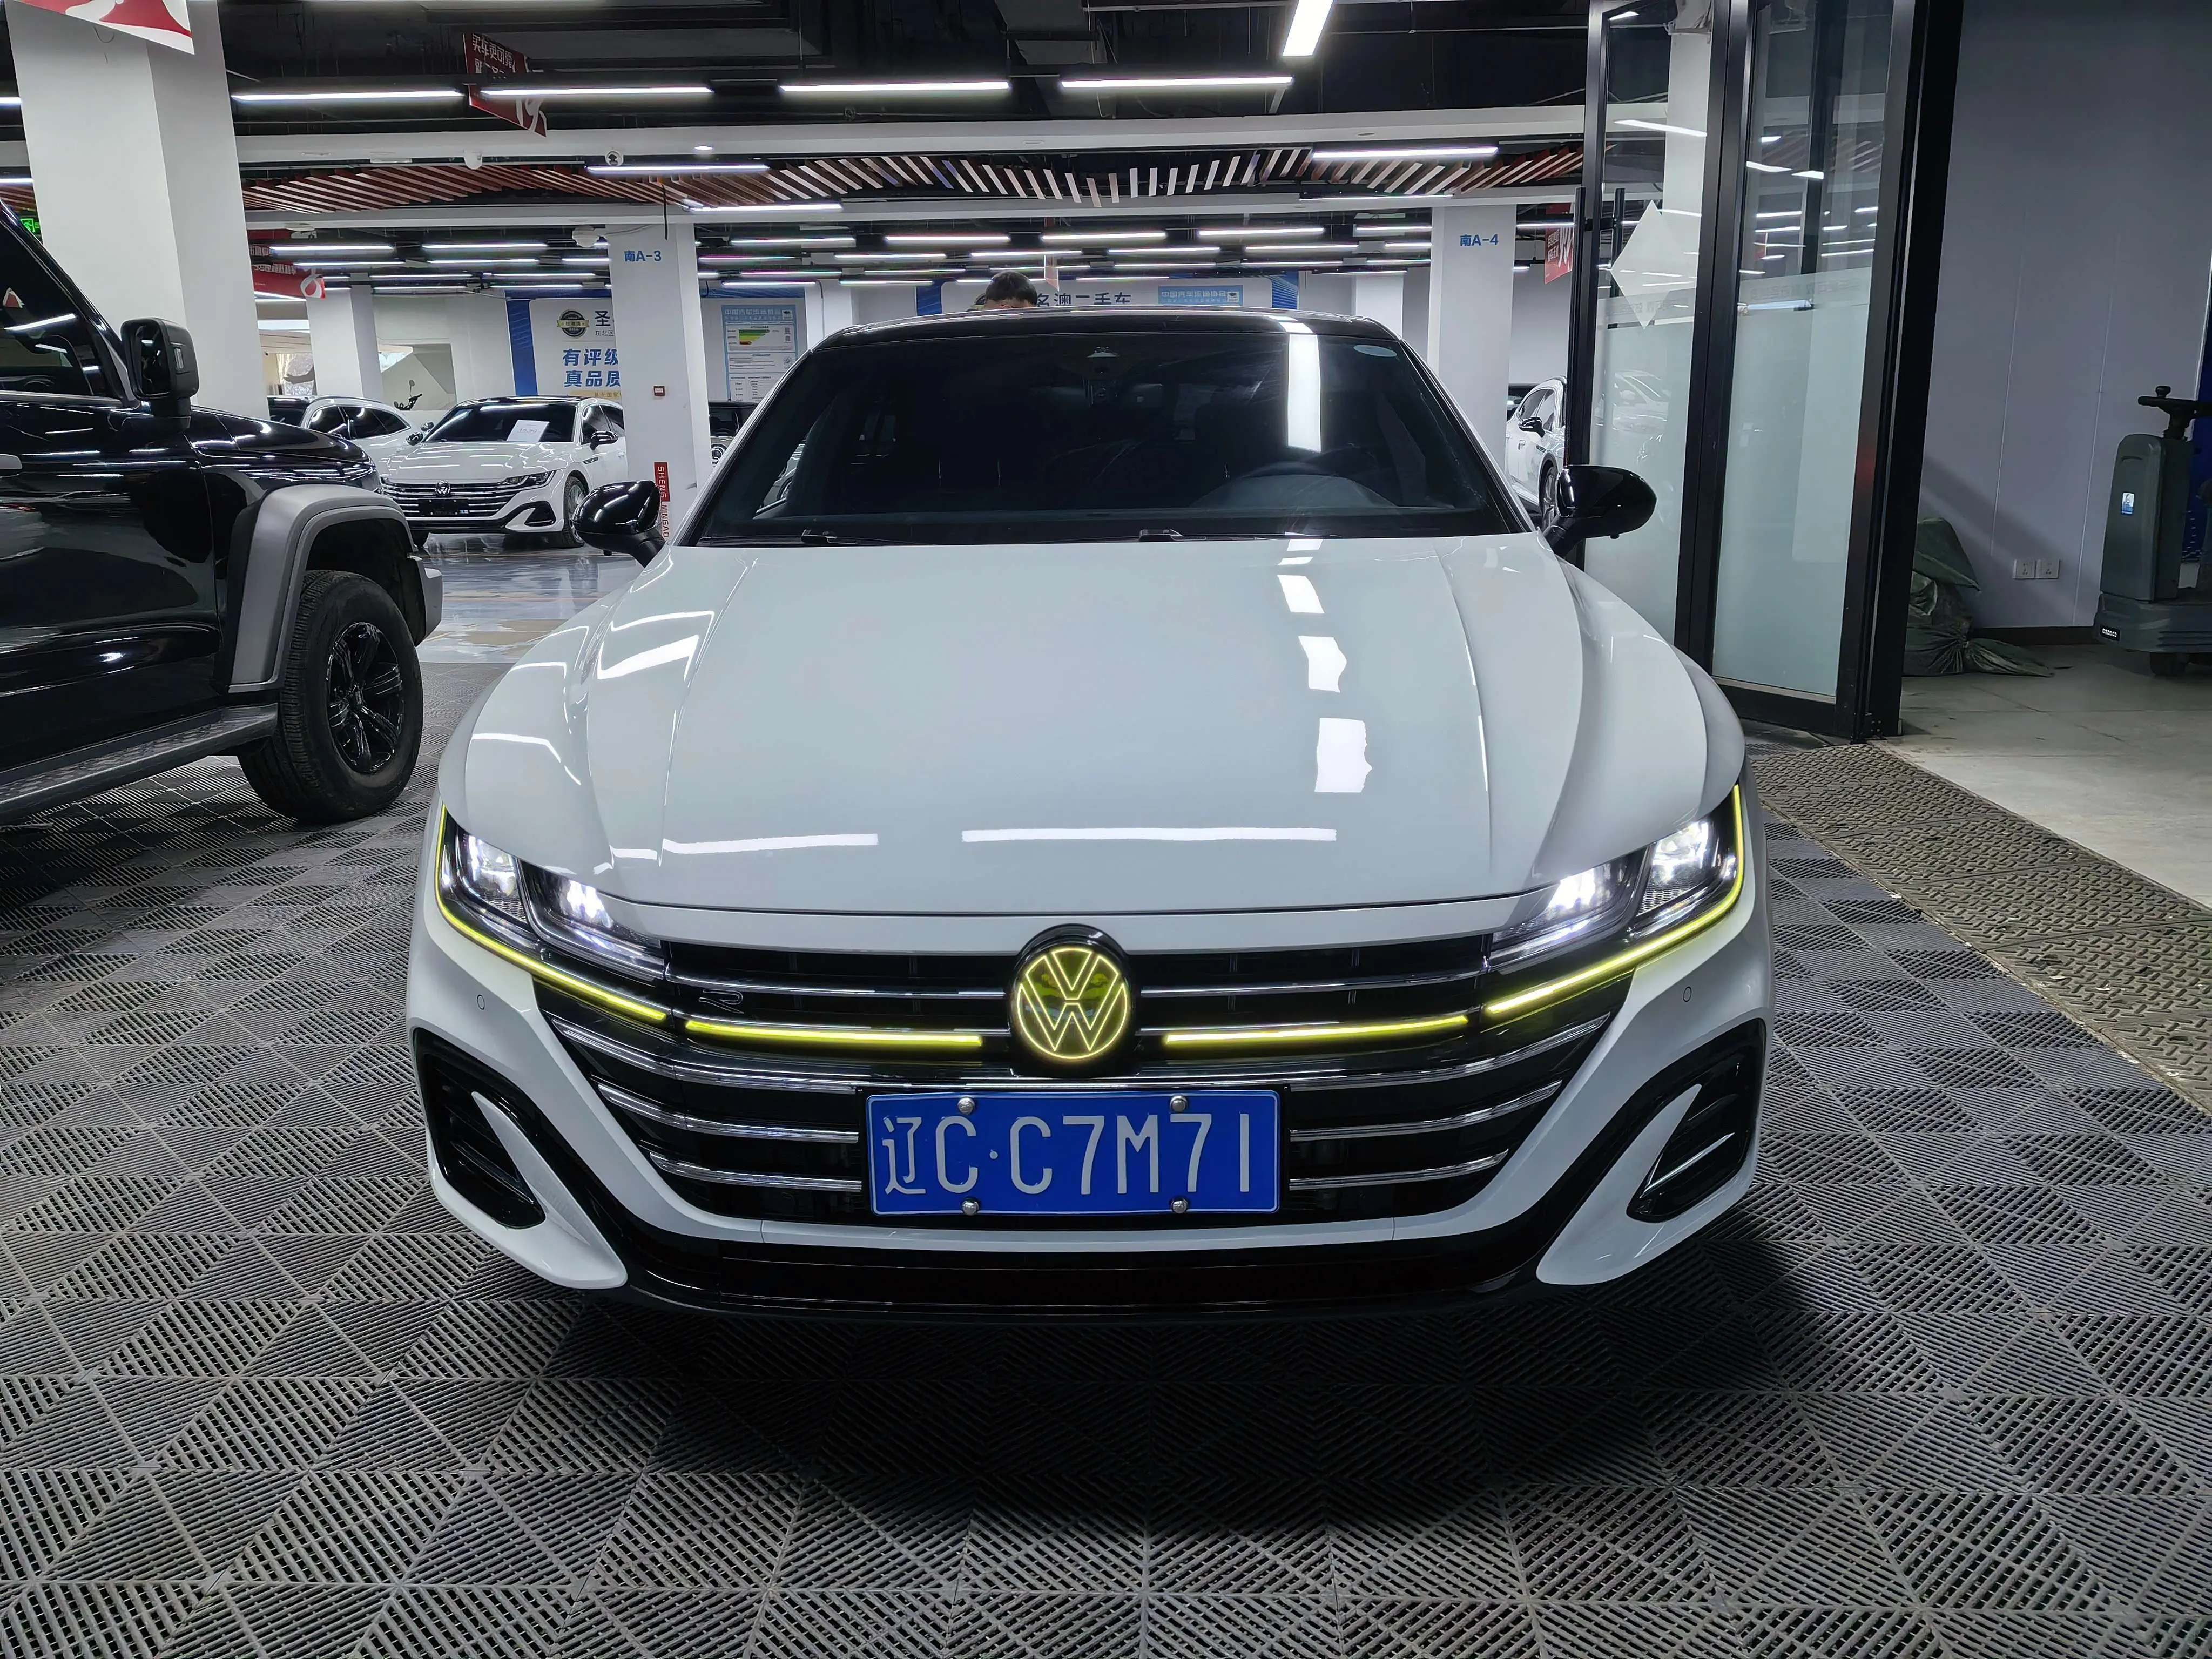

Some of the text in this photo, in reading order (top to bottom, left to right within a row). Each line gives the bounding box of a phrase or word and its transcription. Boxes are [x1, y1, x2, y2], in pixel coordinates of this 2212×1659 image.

[1460, 234, 1499, 246] 南A-4
[624, 250, 662, 262] 南A-3
[594, 311, 611, 326] 圣
[563, 348, 618, 366] 有评级
[564, 370, 621, 387] 真品质
[658, 466, 670, 537] SHENG MINGAO
